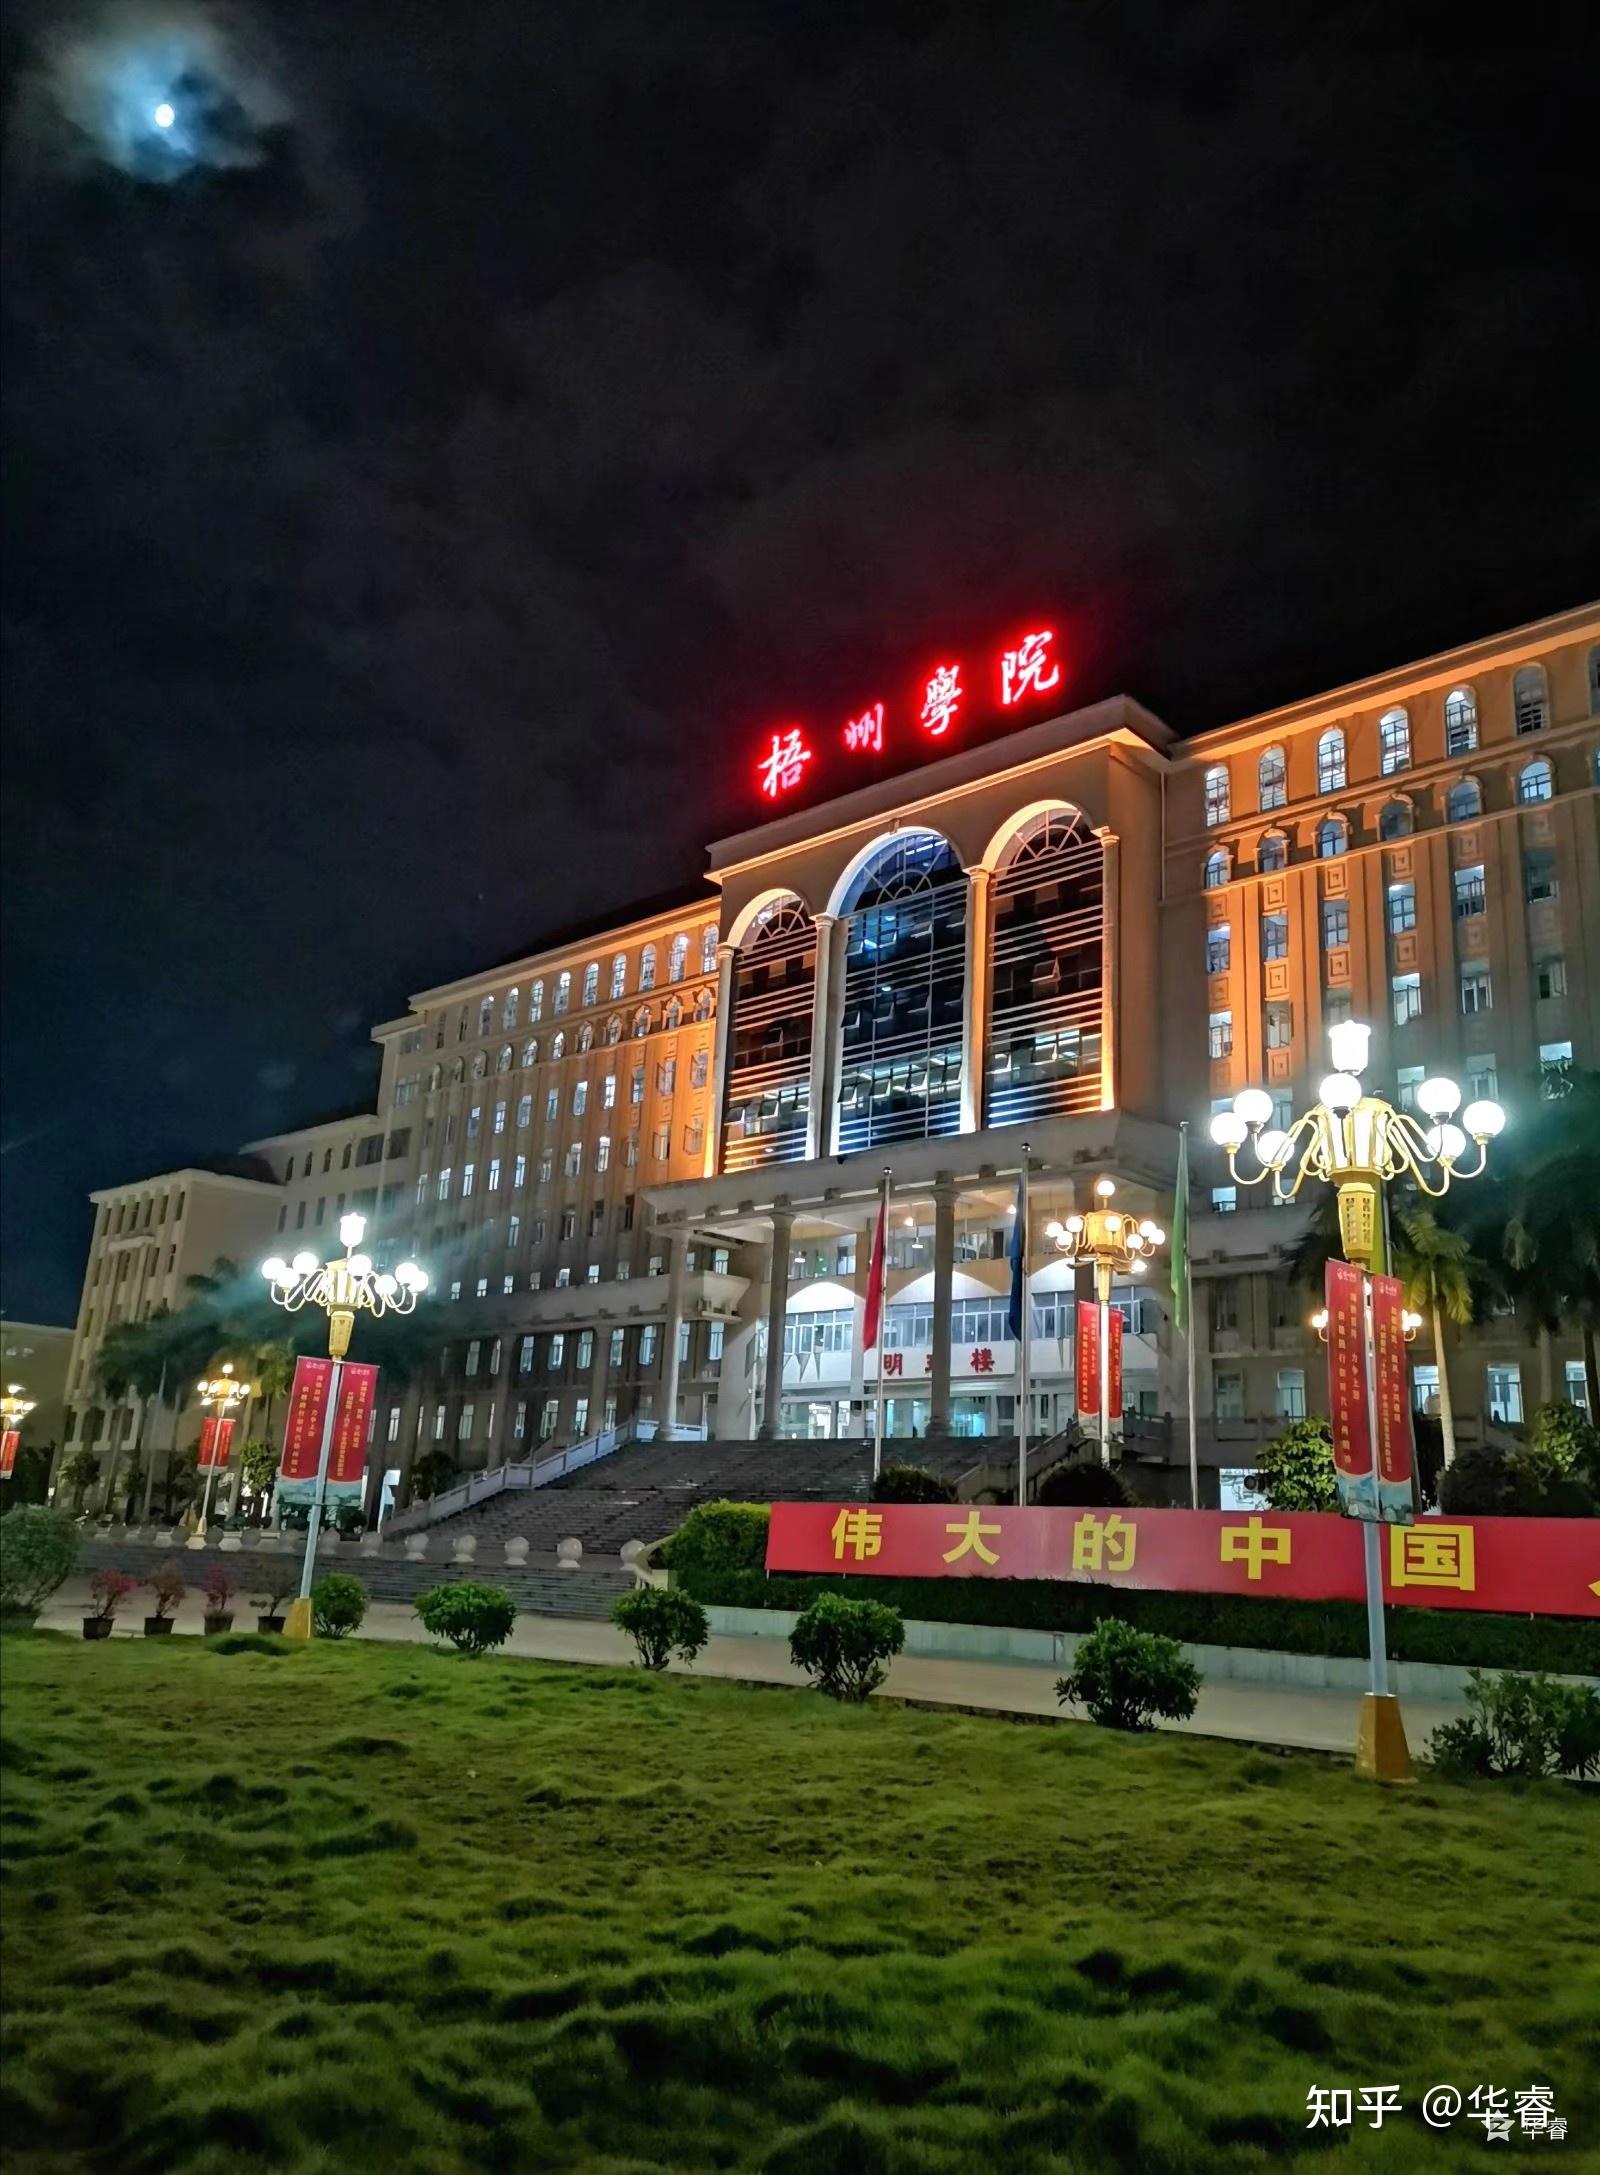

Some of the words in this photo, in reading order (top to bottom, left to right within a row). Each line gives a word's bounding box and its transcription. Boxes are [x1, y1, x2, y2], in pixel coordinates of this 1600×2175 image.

[831, 1508, 1600, 1597] 伟大的中国
